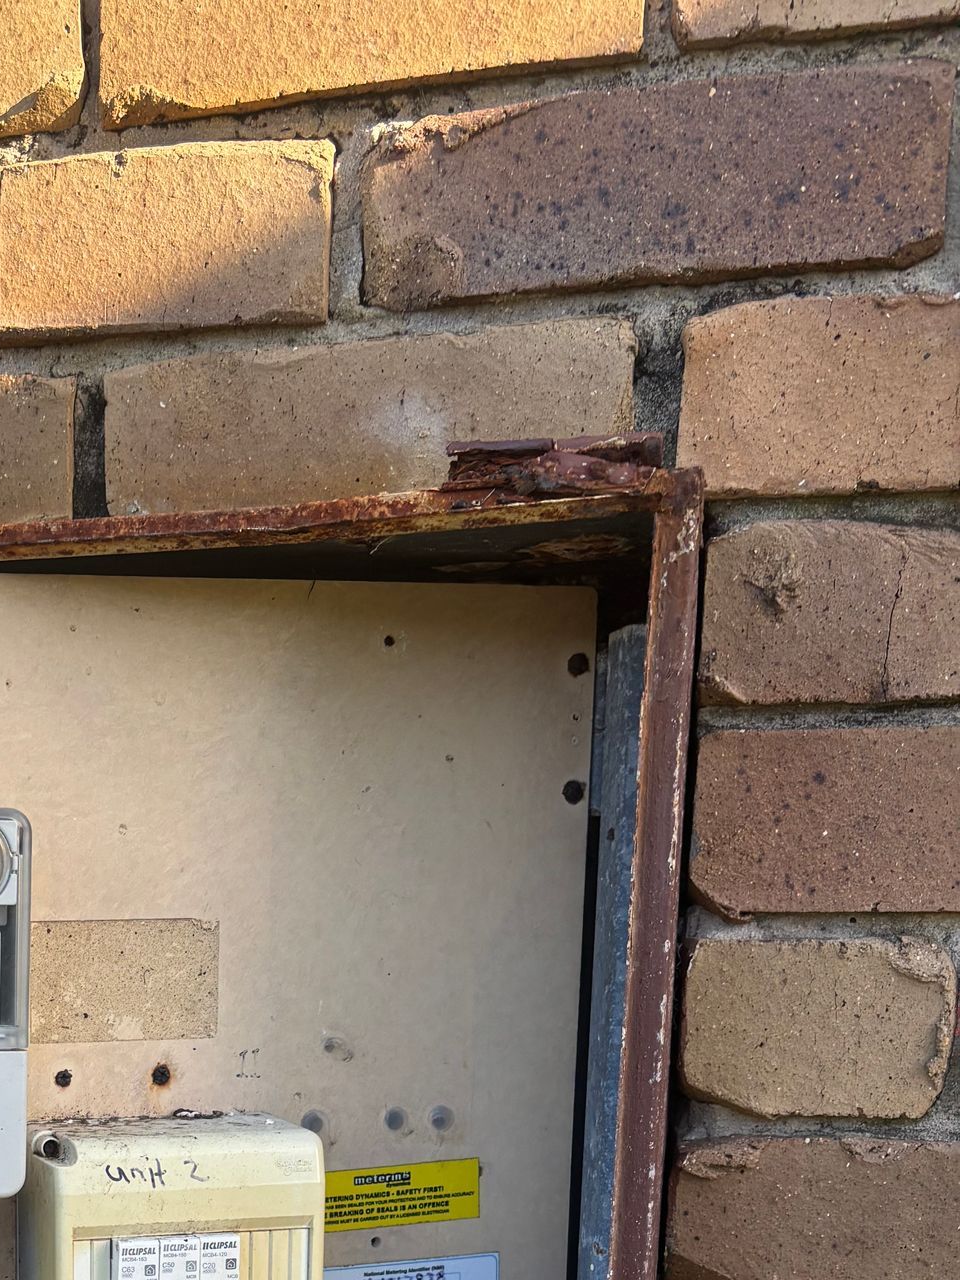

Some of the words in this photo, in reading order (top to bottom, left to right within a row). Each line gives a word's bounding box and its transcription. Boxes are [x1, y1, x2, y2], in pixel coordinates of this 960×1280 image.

[356, 1191, 390, 1200] DYNAMICS
[396, 1188, 422, 1196] SAFETY
[330, 1209, 364, 1219] BREAKING
[377, 1206, 398, 1214] SEALS
[419, 1200, 449, 1209] OFFENCE
[169, 1243, 198, 1252] CLIPSAL
[209, 1240, 237, 1250] CLIPSAL
[128, 1247, 156, 1256] CLIPSAL
